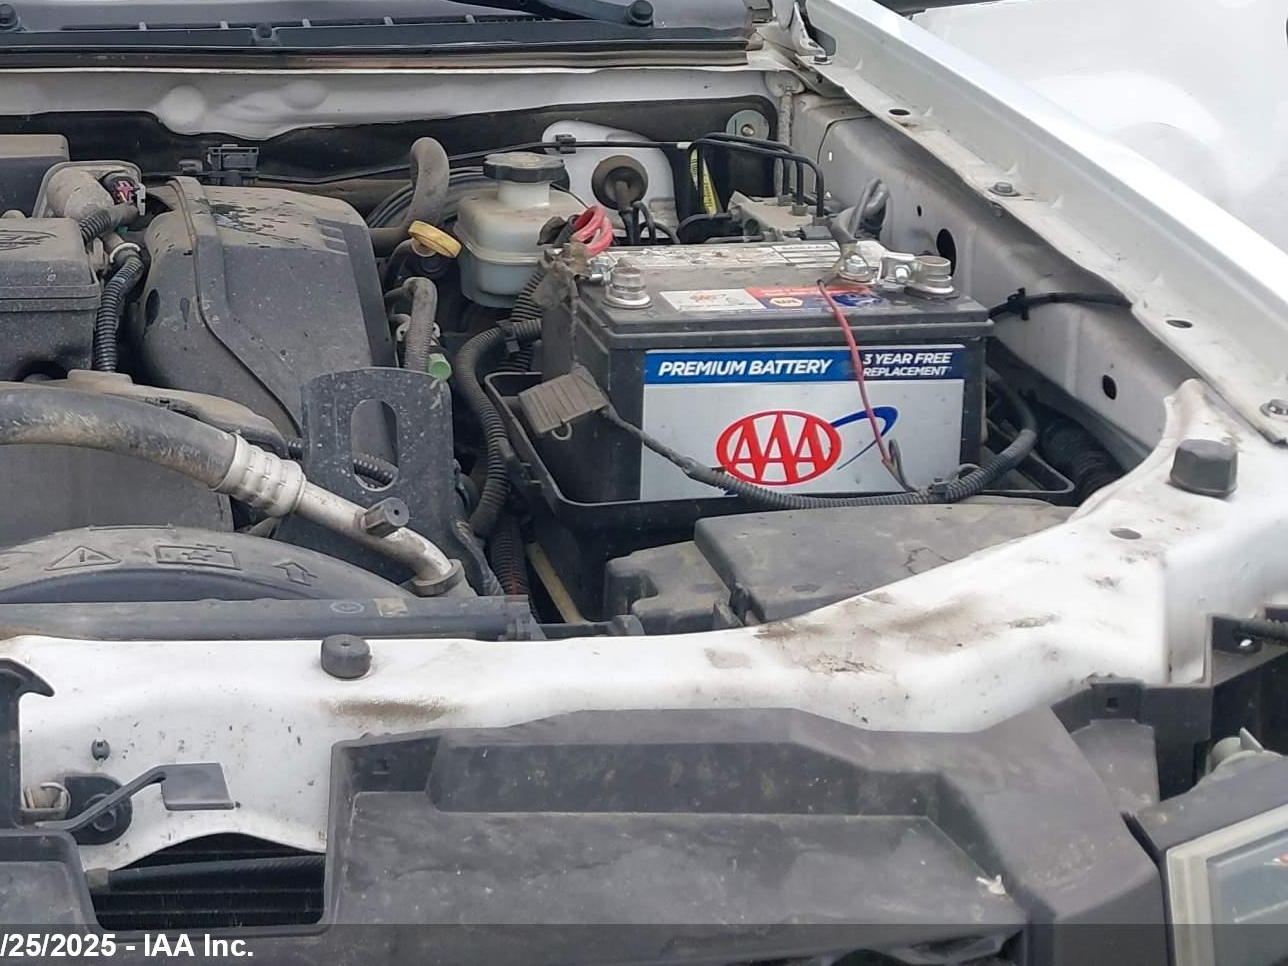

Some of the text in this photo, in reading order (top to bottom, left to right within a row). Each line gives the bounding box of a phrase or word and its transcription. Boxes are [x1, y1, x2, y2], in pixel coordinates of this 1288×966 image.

[863, 352, 952, 365] 3 YEAR FREE
[658, 359, 834, 376] PREMIUM BATTERY
[722, 412, 832, 483] AAA
